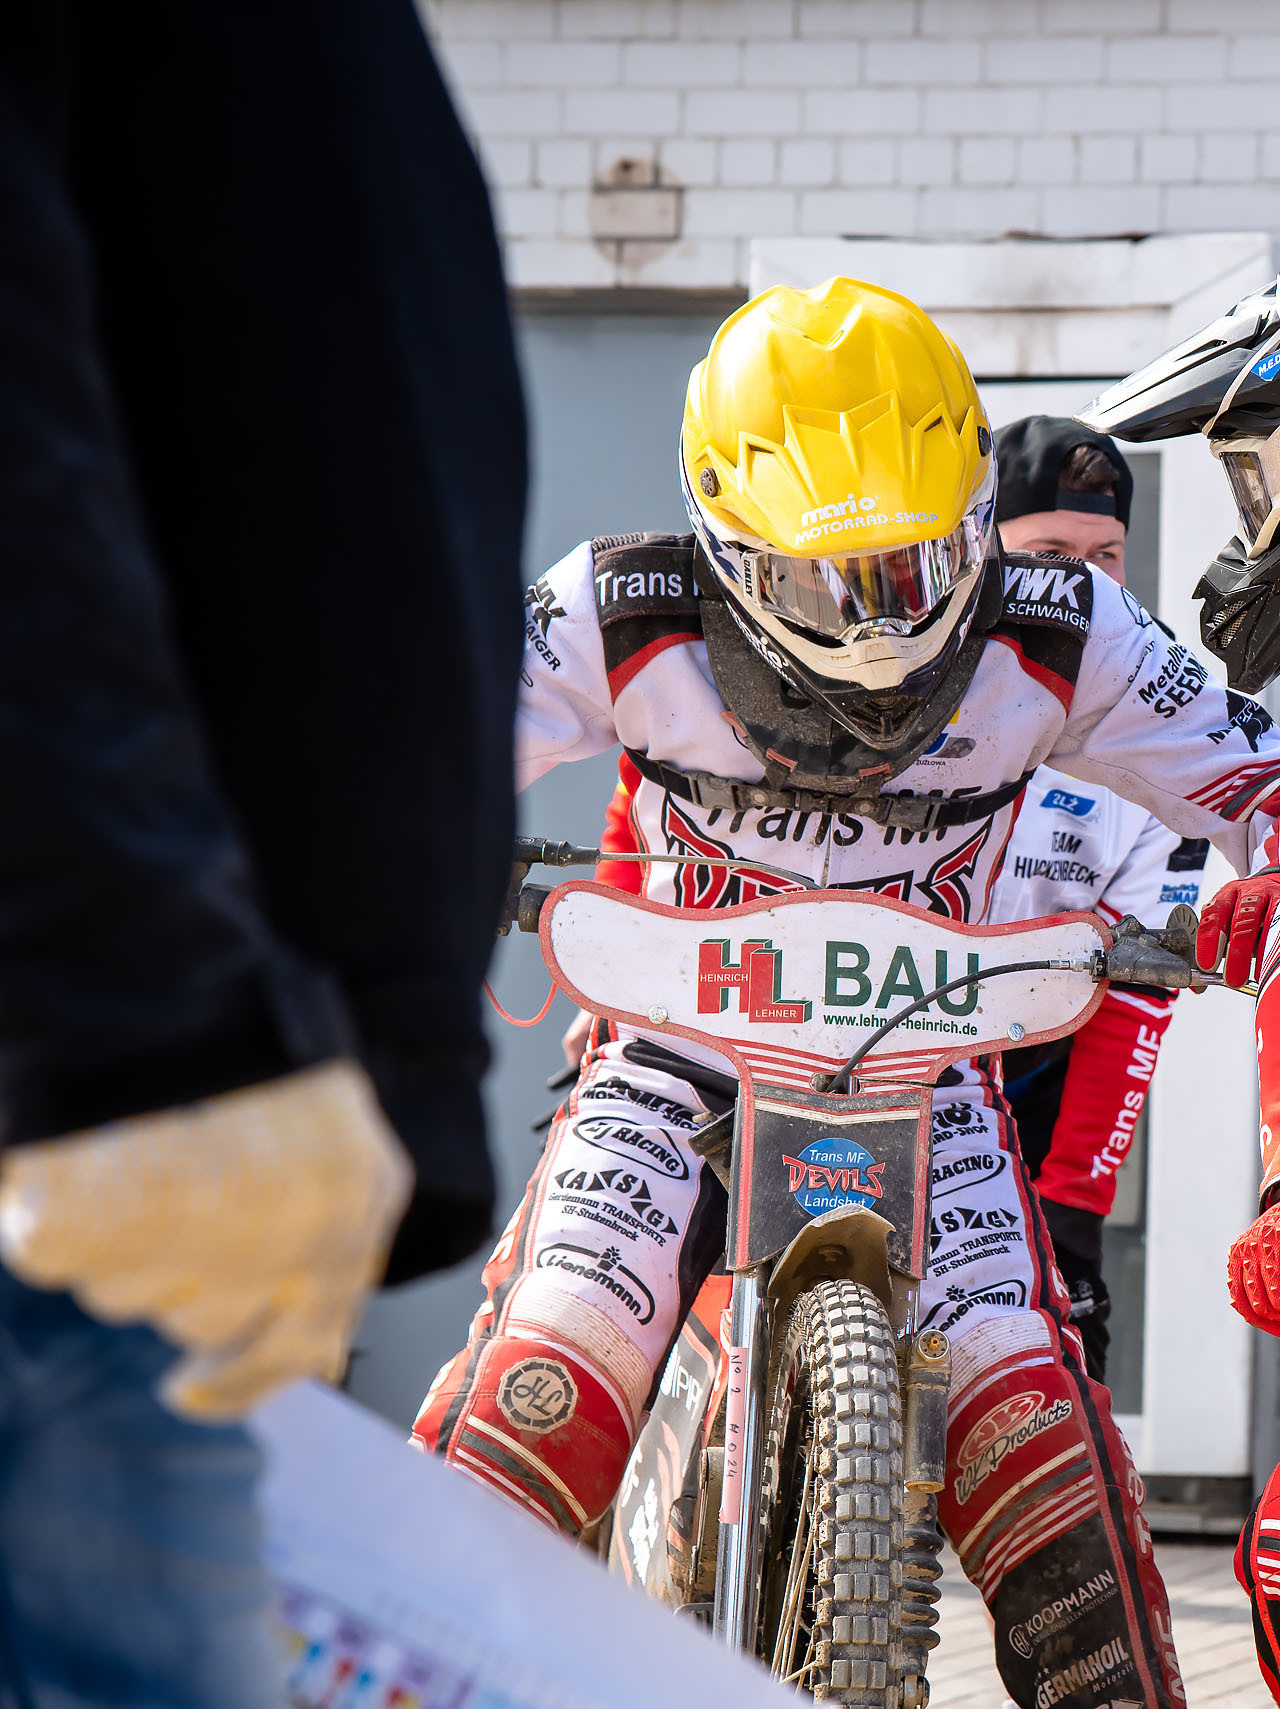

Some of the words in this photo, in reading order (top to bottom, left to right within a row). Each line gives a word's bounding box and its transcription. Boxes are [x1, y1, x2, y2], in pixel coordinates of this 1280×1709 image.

[795, 512, 939, 546] MOTORRAD-SHOP
[595, 570, 683, 607] Trans
[744, 559, 753, 598] OAKLEY
[1006, 602, 1091, 634] SCHWAIGER
[1051, 831, 1083, 854] TEAM
[1014, 856, 1101, 887] HUCKENBECK
[700, 972, 749, 984] HEINRICH
[824, 940, 981, 1017] BAU
[754, 1008, 797, 1019] LEHNER
[823, 1013, 978, 1036] www.lehn-heinrich.de
[1126, 1024, 1160, 1081] MF
[611, 1126, 680, 1173] RACING
[1090, 1089, 1145, 1179] Trans
[809, 1149, 843, 1162] Trans
[846, 1151, 866, 1164] MF
[932, 1154, 994, 1185] RACING
[782, 1153, 886, 1199] DEVILS
[561, 1204, 640, 1242] SH-Stukenbrock
[602, 1202, 667, 1248] TRANSPORTE
[959, 1231, 1023, 1252] TRANSPORTE
[933, 1243, 1011, 1277] SH-Stukenbrock
[547, 1254, 642, 1316] Lienemann
[985, 1401, 1070, 1469] Products
[1025, 1569, 1115, 1637] KOOPMANN
[1036, 1636, 1129, 1709] GERMANOIL
